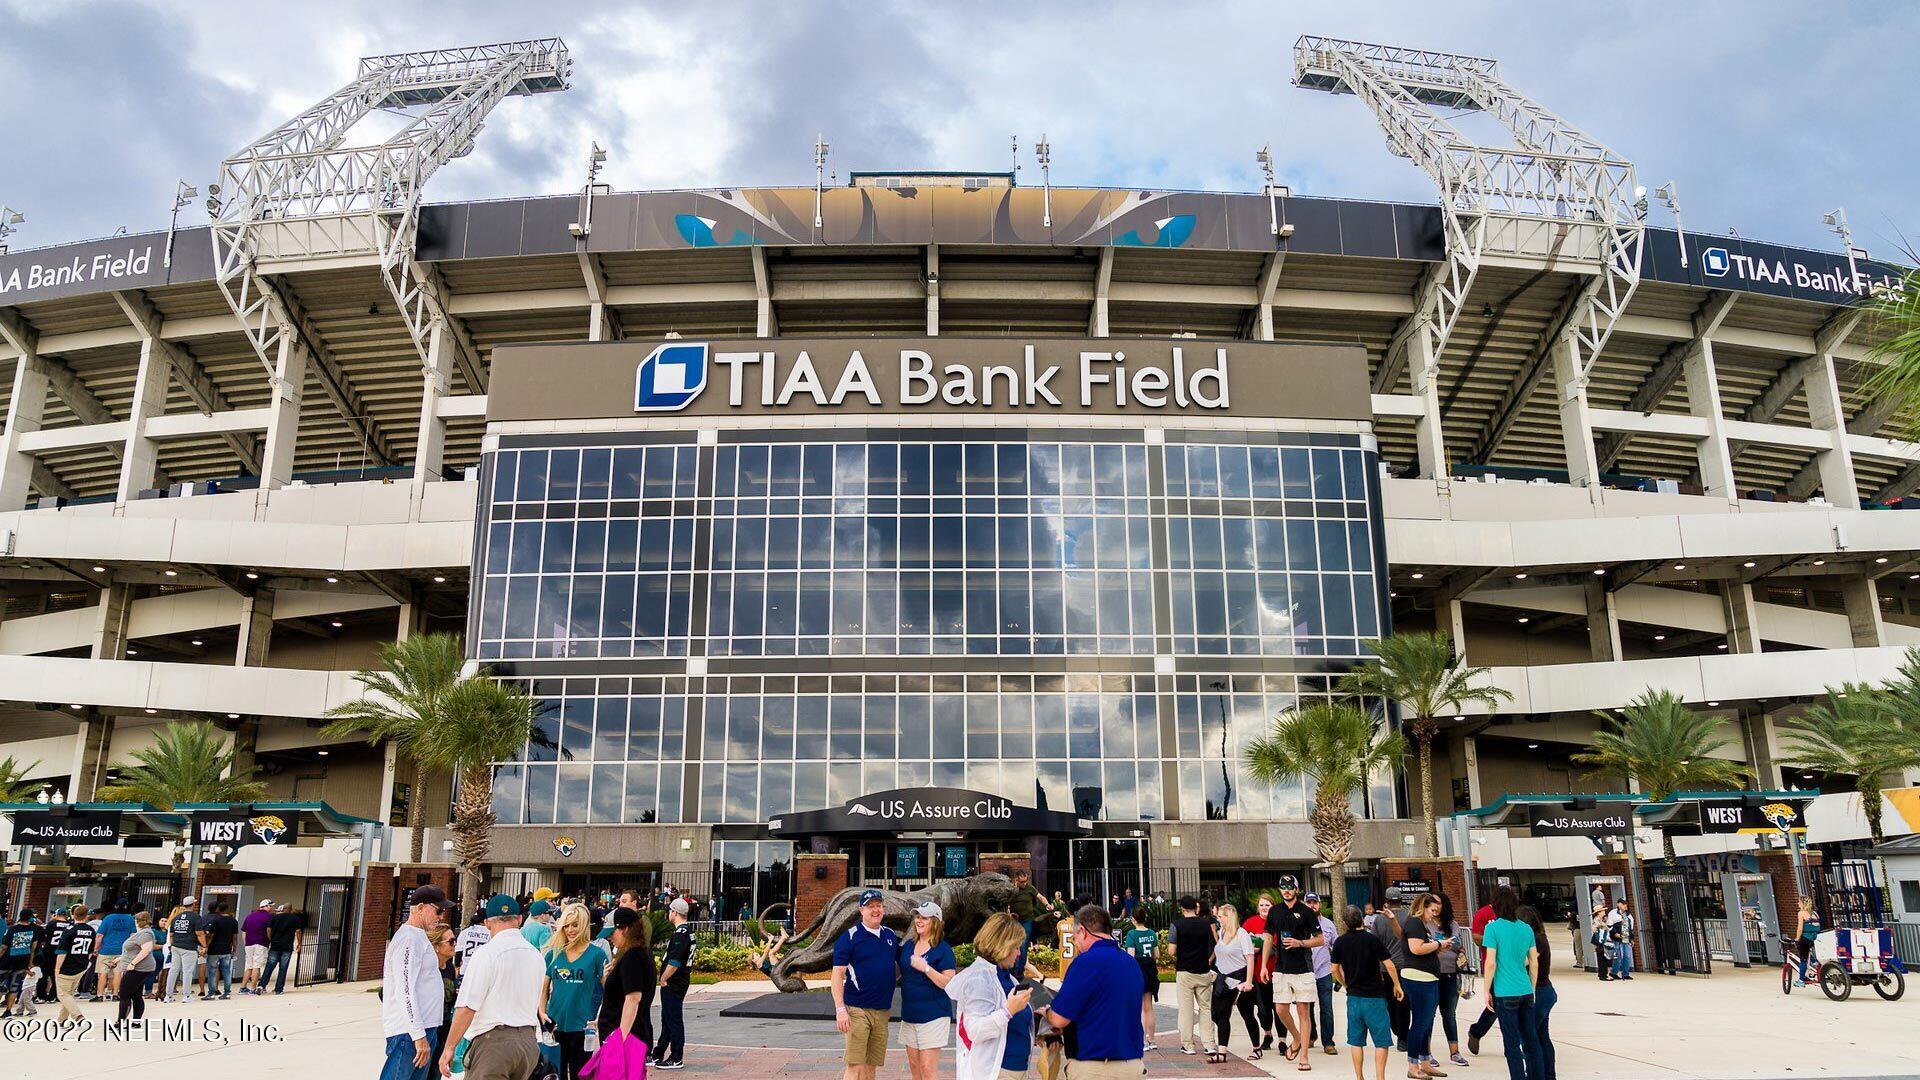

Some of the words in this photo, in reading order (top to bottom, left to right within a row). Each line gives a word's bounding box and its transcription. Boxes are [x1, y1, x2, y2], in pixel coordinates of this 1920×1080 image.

[27, 256, 87, 290] Bank
[90, 246, 152, 280] Field
[1730, 253, 1792, 286] TIAA
[1794, 263, 1853, 294] Bank
[714, 350, 883, 407] TIAA
[899, 344, 1063, 406] Bank
[1080, 346, 1230, 410] Field
[880, 800, 905, 819] US
[909, 801, 971, 819] Assure
[974, 799, 1012, 819] Club
[1708, 807, 1743, 825] WEST
[40, 826, 55, 837] US
[56, 826, 89, 837] Assure
[91, 826, 113, 837] Club
[200, 821, 245, 841] WEST
[1554, 817, 1569, 828] US
[1570, 817, 1603, 828] Assure
[1604, 816, 1625, 828] Club
[70, 937, 93, 955] 20
[1062, 932, 1074, 958] 5
[1142, 943, 1152, 957] 5
